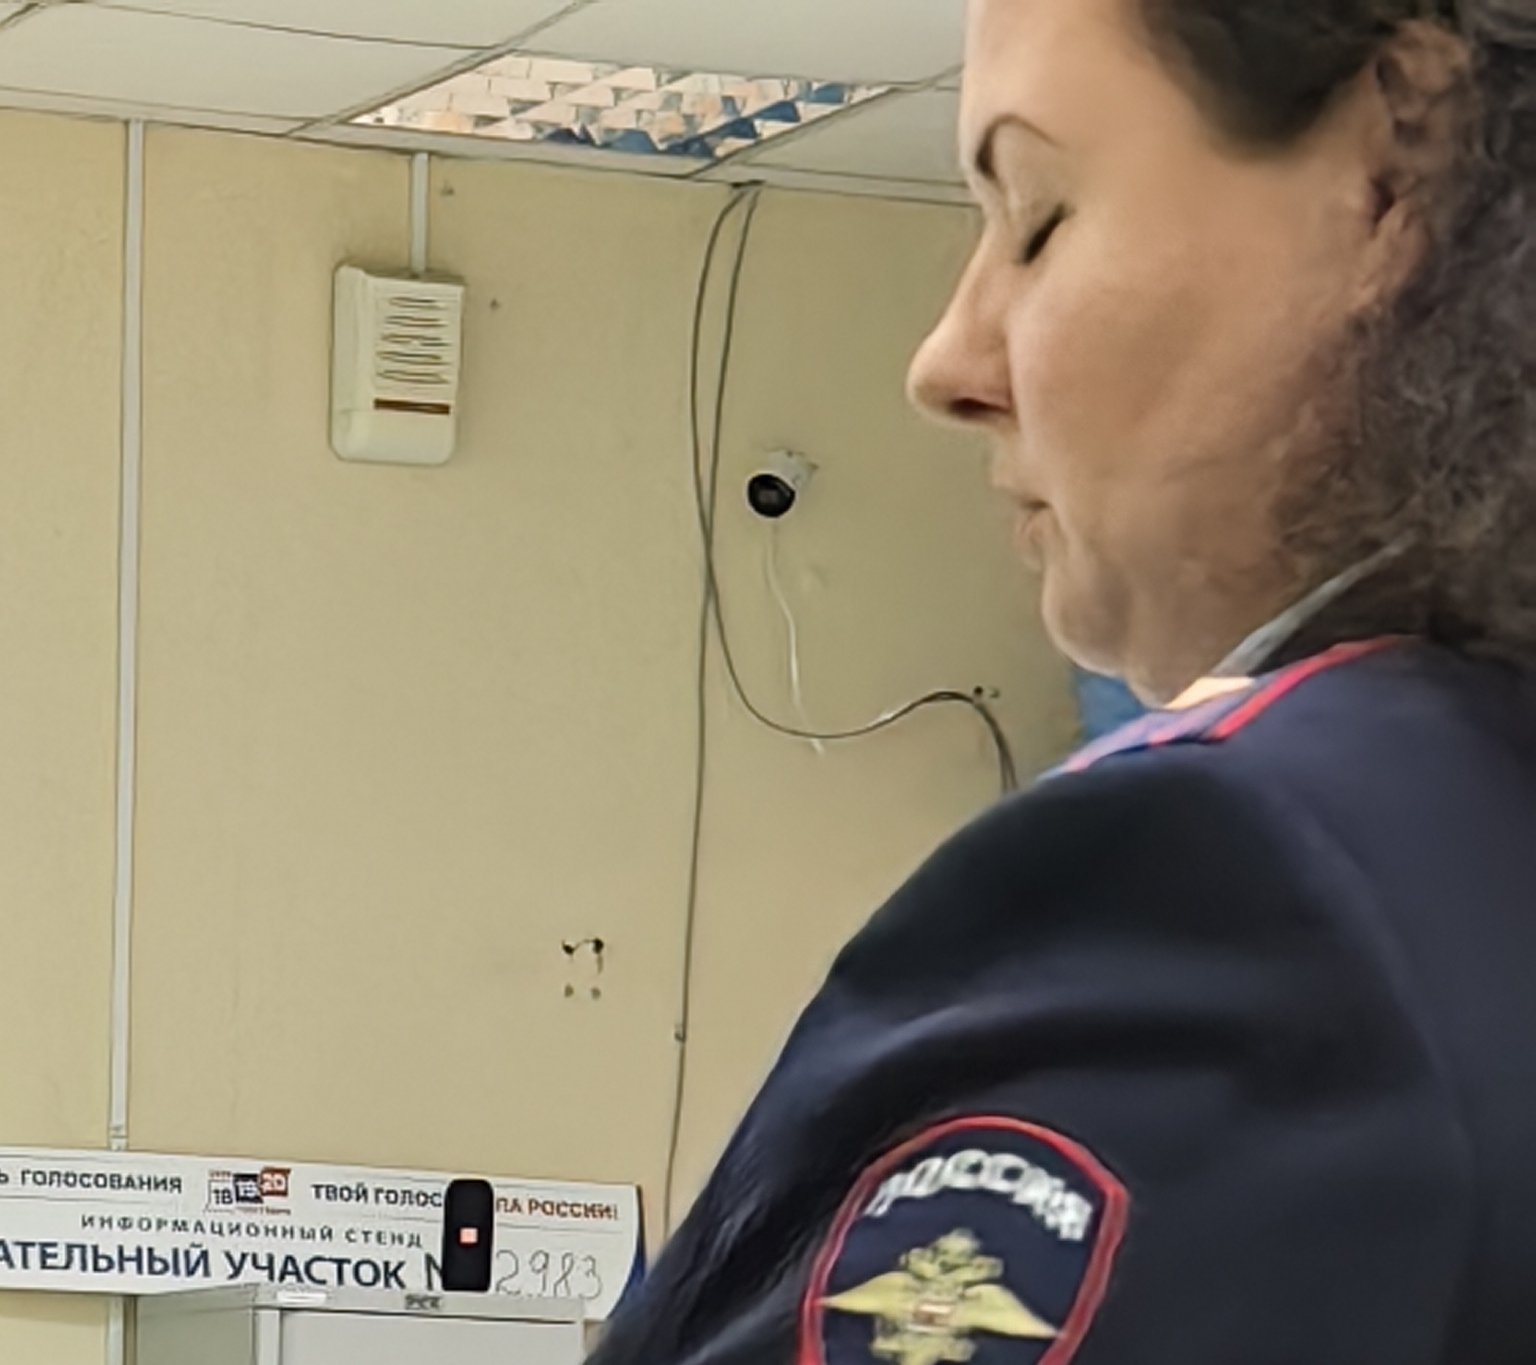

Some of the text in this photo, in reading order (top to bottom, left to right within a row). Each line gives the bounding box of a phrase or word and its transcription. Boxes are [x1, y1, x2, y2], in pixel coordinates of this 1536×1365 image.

[20, 1170, 183, 1194] ГОЛОСОВАНИЯ
[311, 1182, 368, 1204] ТВОЙ
[374, 1187, 442, 1207] ГОЛОС
[81, 1214, 423, 1248] ИНФОРМАЦИОННЫЙ СТЕНД
[224, 1250, 406, 1290] УЧАСТОК
[495, 1249, 603, 1300] 2983
